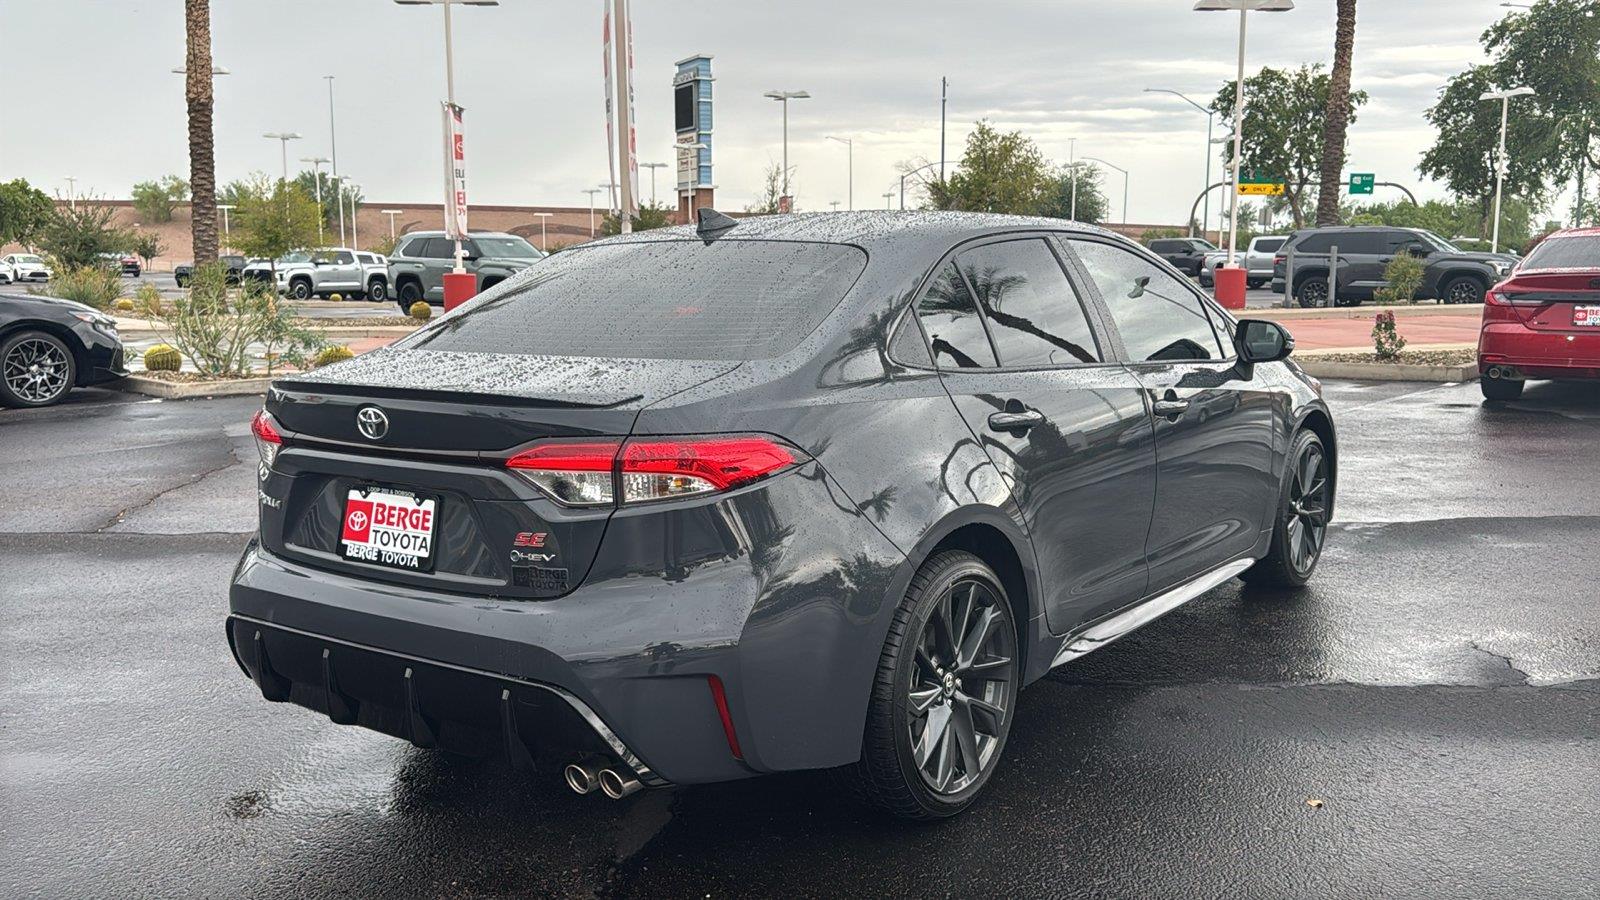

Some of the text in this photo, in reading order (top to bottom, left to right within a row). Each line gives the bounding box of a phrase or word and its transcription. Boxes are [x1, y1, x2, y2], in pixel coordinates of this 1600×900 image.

[373, 502, 432, 532] BERGE
[372, 529, 429, 553] TOYOTA
[514, 532, 547, 547] SE
[346, 544, 419, 568] BERGE TOYOTA
[529, 568, 567, 579] BERGE
[530, 578, 570, 591] TOYOTA
